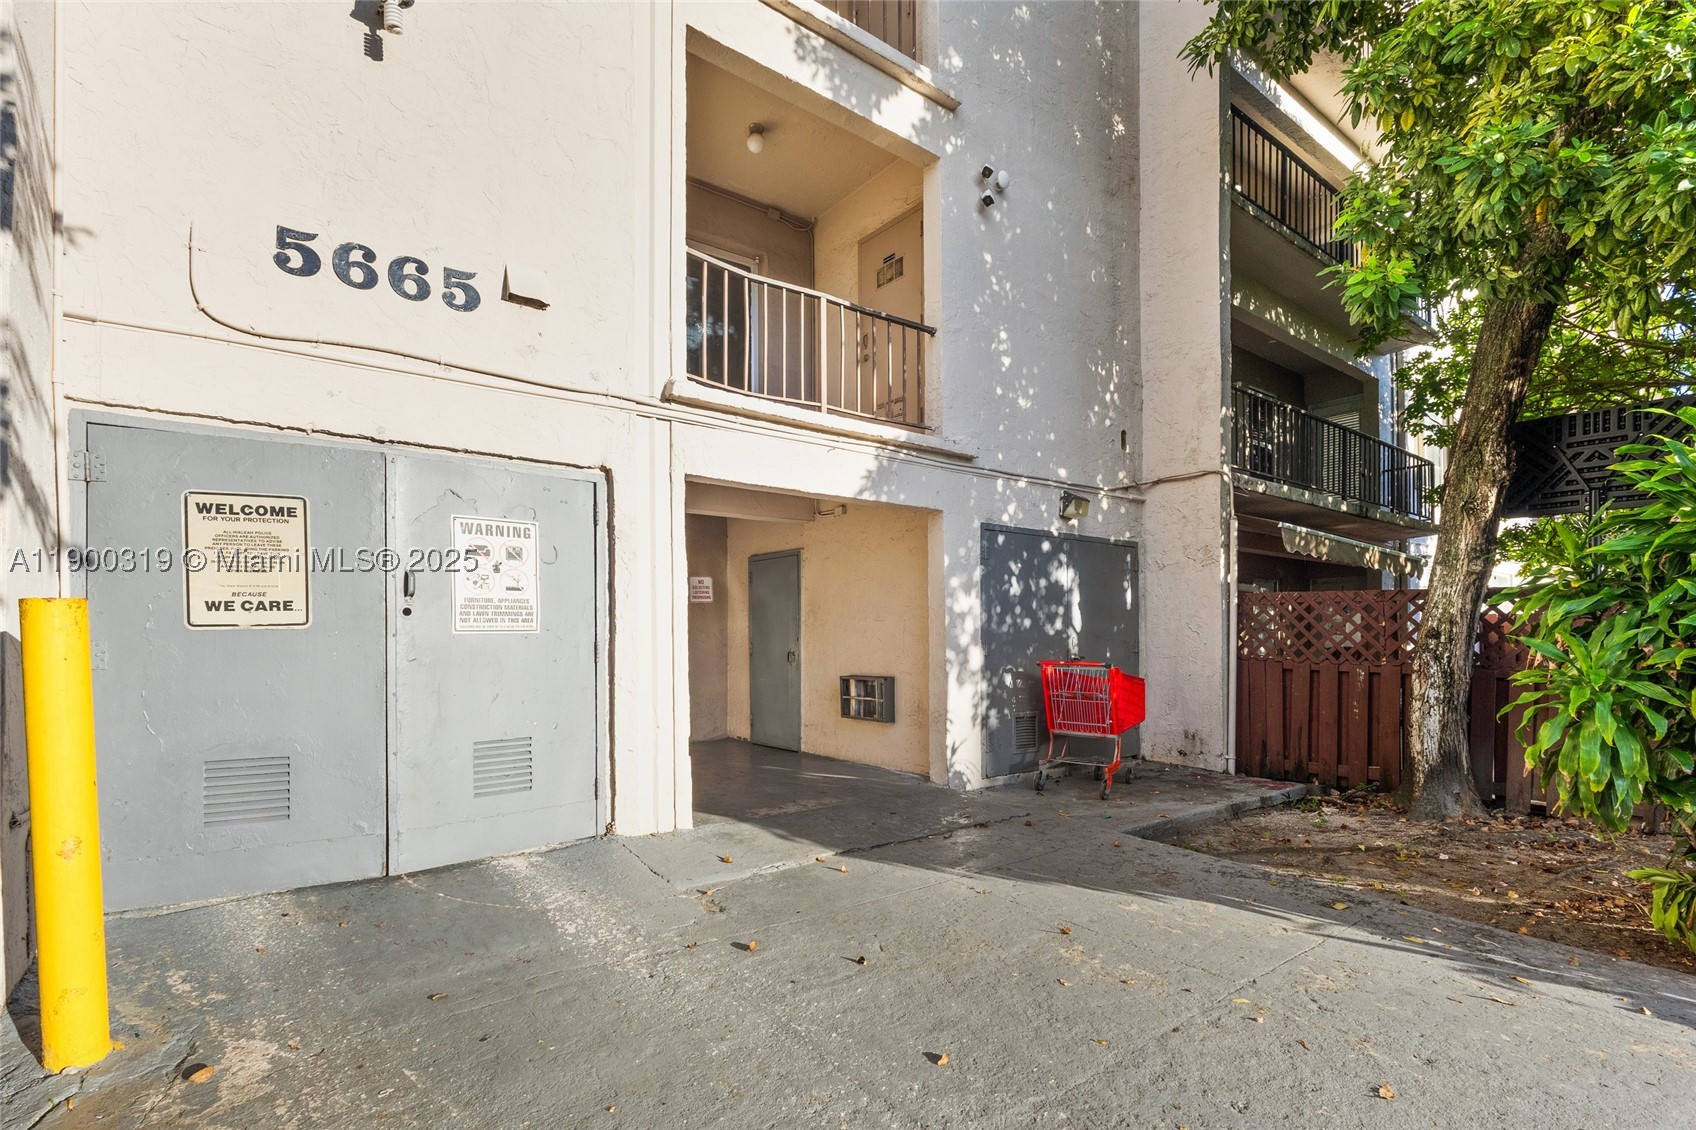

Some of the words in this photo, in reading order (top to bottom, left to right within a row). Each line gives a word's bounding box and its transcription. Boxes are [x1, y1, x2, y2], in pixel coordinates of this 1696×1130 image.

[273, 225, 481, 312] 5665
[195, 502, 297, 517] WELCOME
[460, 522, 531, 539] WARNING
[205, 600, 235, 611] WE
